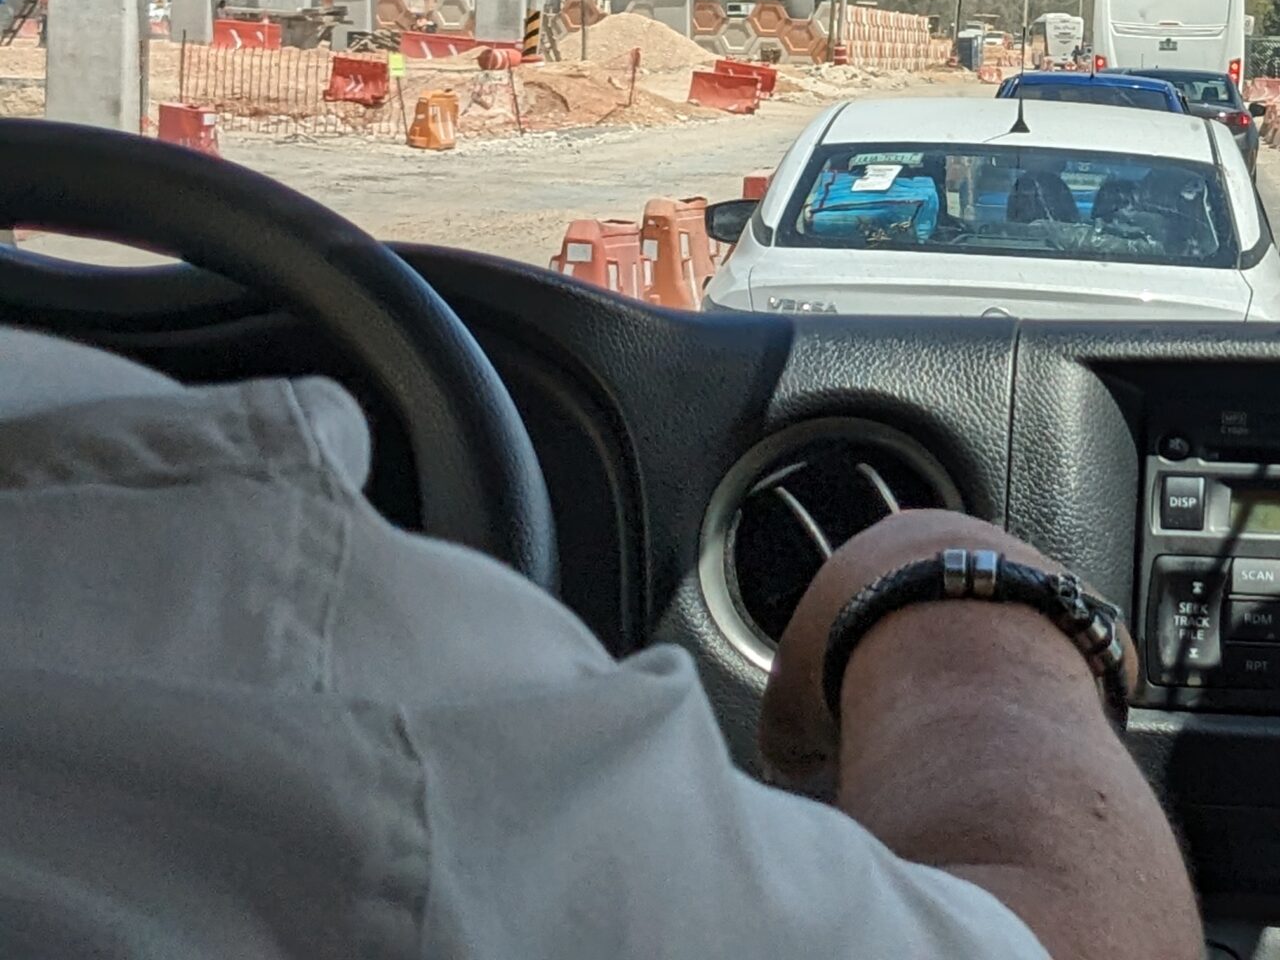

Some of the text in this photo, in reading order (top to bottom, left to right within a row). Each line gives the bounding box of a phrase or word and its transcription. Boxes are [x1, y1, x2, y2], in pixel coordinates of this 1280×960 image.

[767, 296, 838, 314] VERSA
[1169, 496, 1197, 508] DISP
[1241, 570, 1275, 582] SCAN
[1178, 601, 1209, 614] SEEK
[1173, 614, 1210, 628] TRACK
[1244, 613, 1273, 625] RDM
[1179, 628, 1205, 640] FILE
[1245, 659, 1268, 671] RPT
